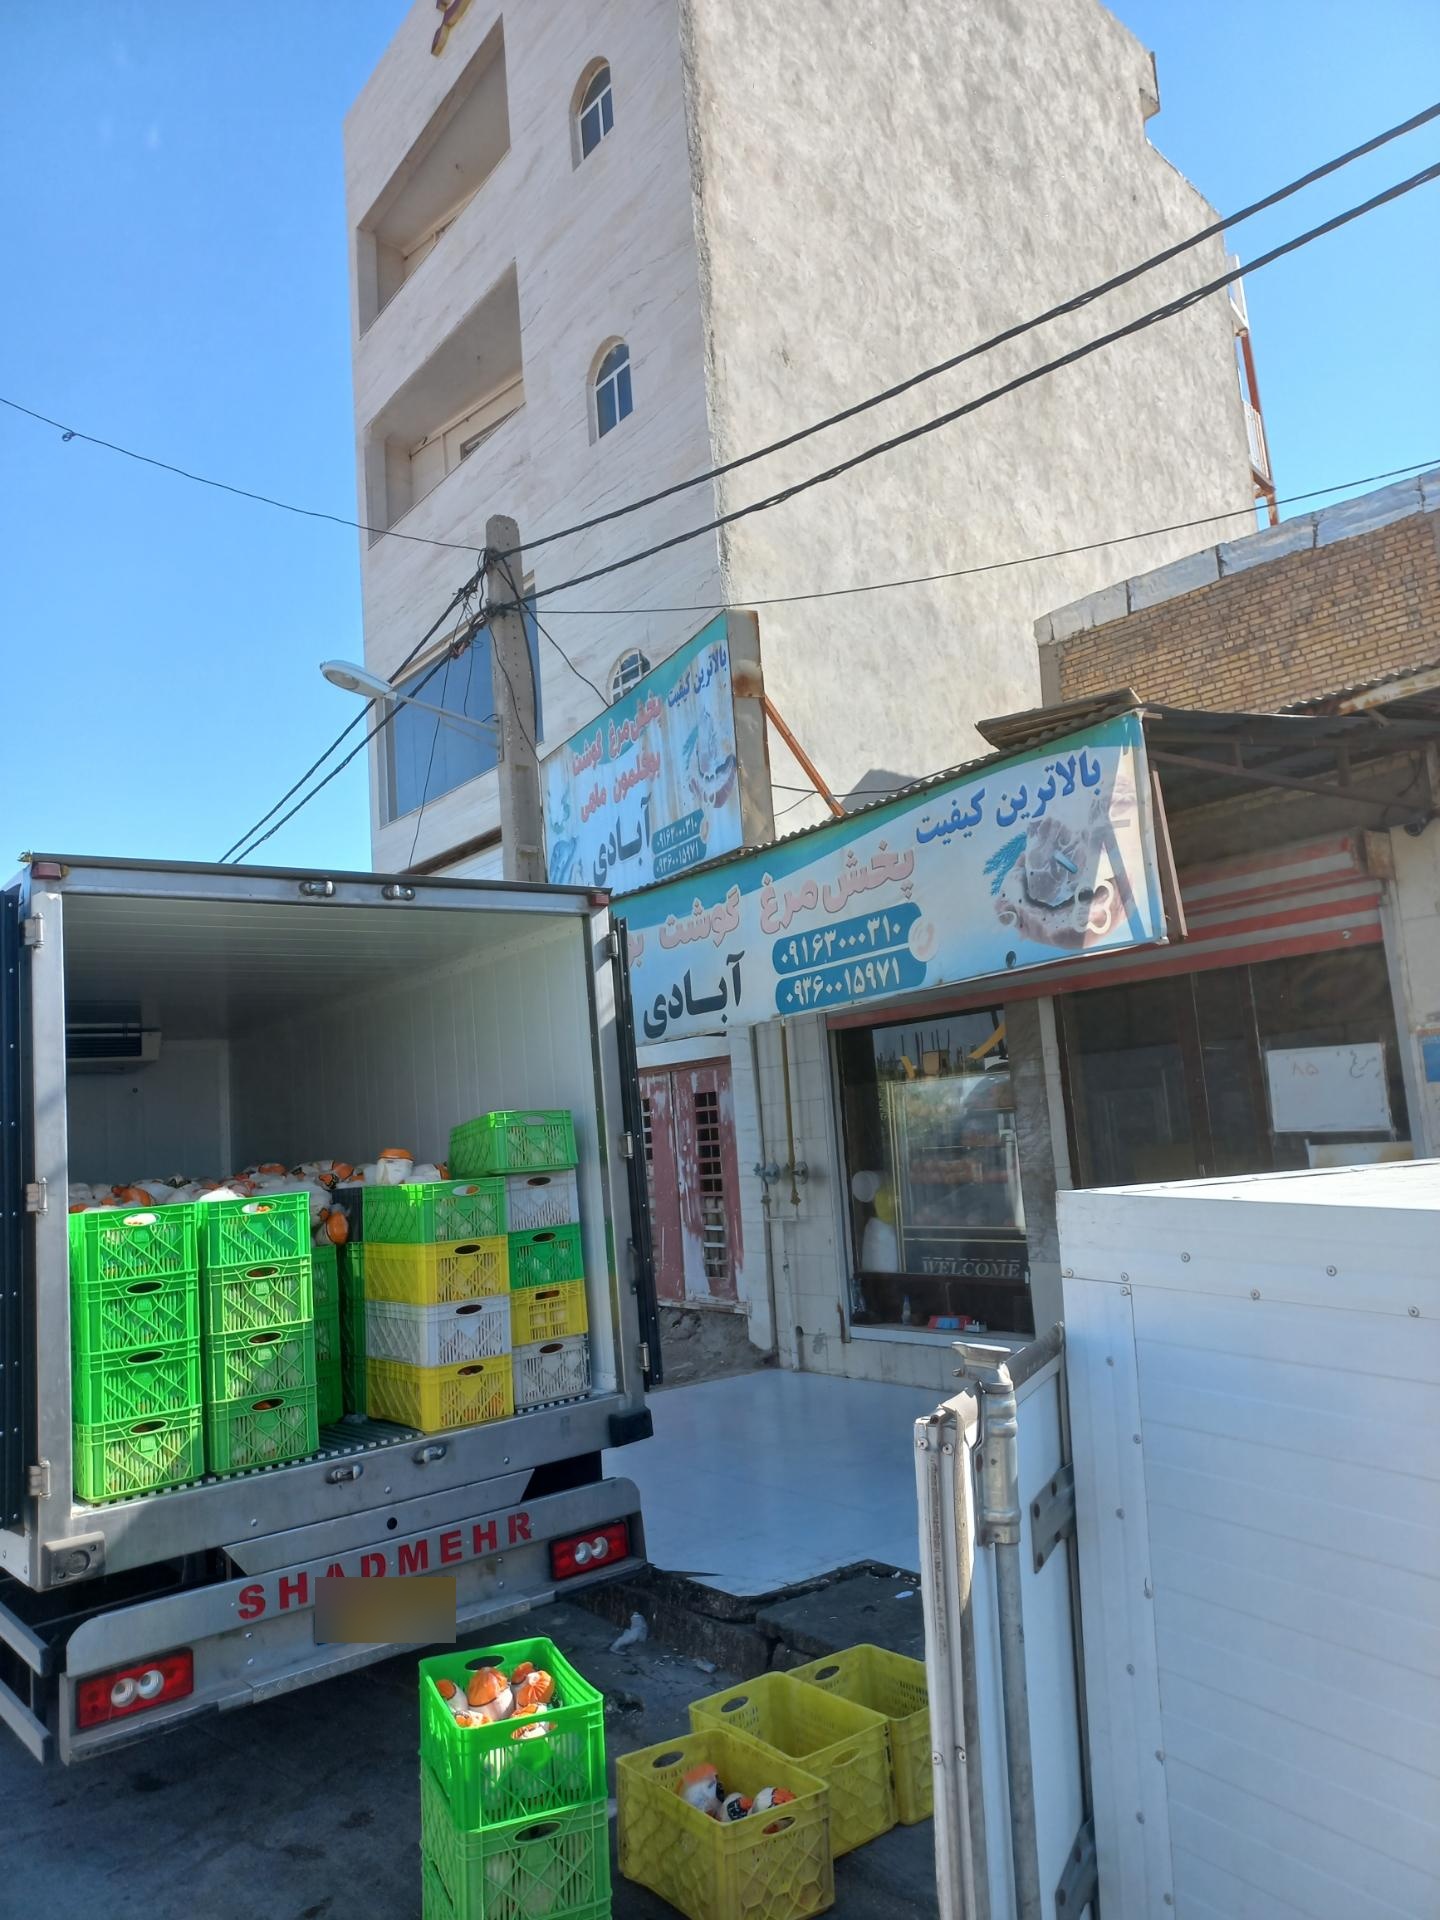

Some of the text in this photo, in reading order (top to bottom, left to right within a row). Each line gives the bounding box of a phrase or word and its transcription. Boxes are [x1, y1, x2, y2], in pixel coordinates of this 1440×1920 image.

[608, 719, 631, 758] مرغ
[915, 750, 1101, 846] بالاترین کیفیت
[593, 792, 652, 887] آبادی
[760, 872, 820, 936] مرغ
[822, 839, 915, 914] پخش
[658, 882, 741, 949] گوشت
[780, 912, 901, 967] ۰۹۱۶۳۰۰۰۳۱۰
[643, 950, 745, 1039] آبادی
[785, 955, 901, 1007] ۰۹۳۶۰۰۱۵۹۷۱
[921, 1259, 1021, 1278] WELCOME
